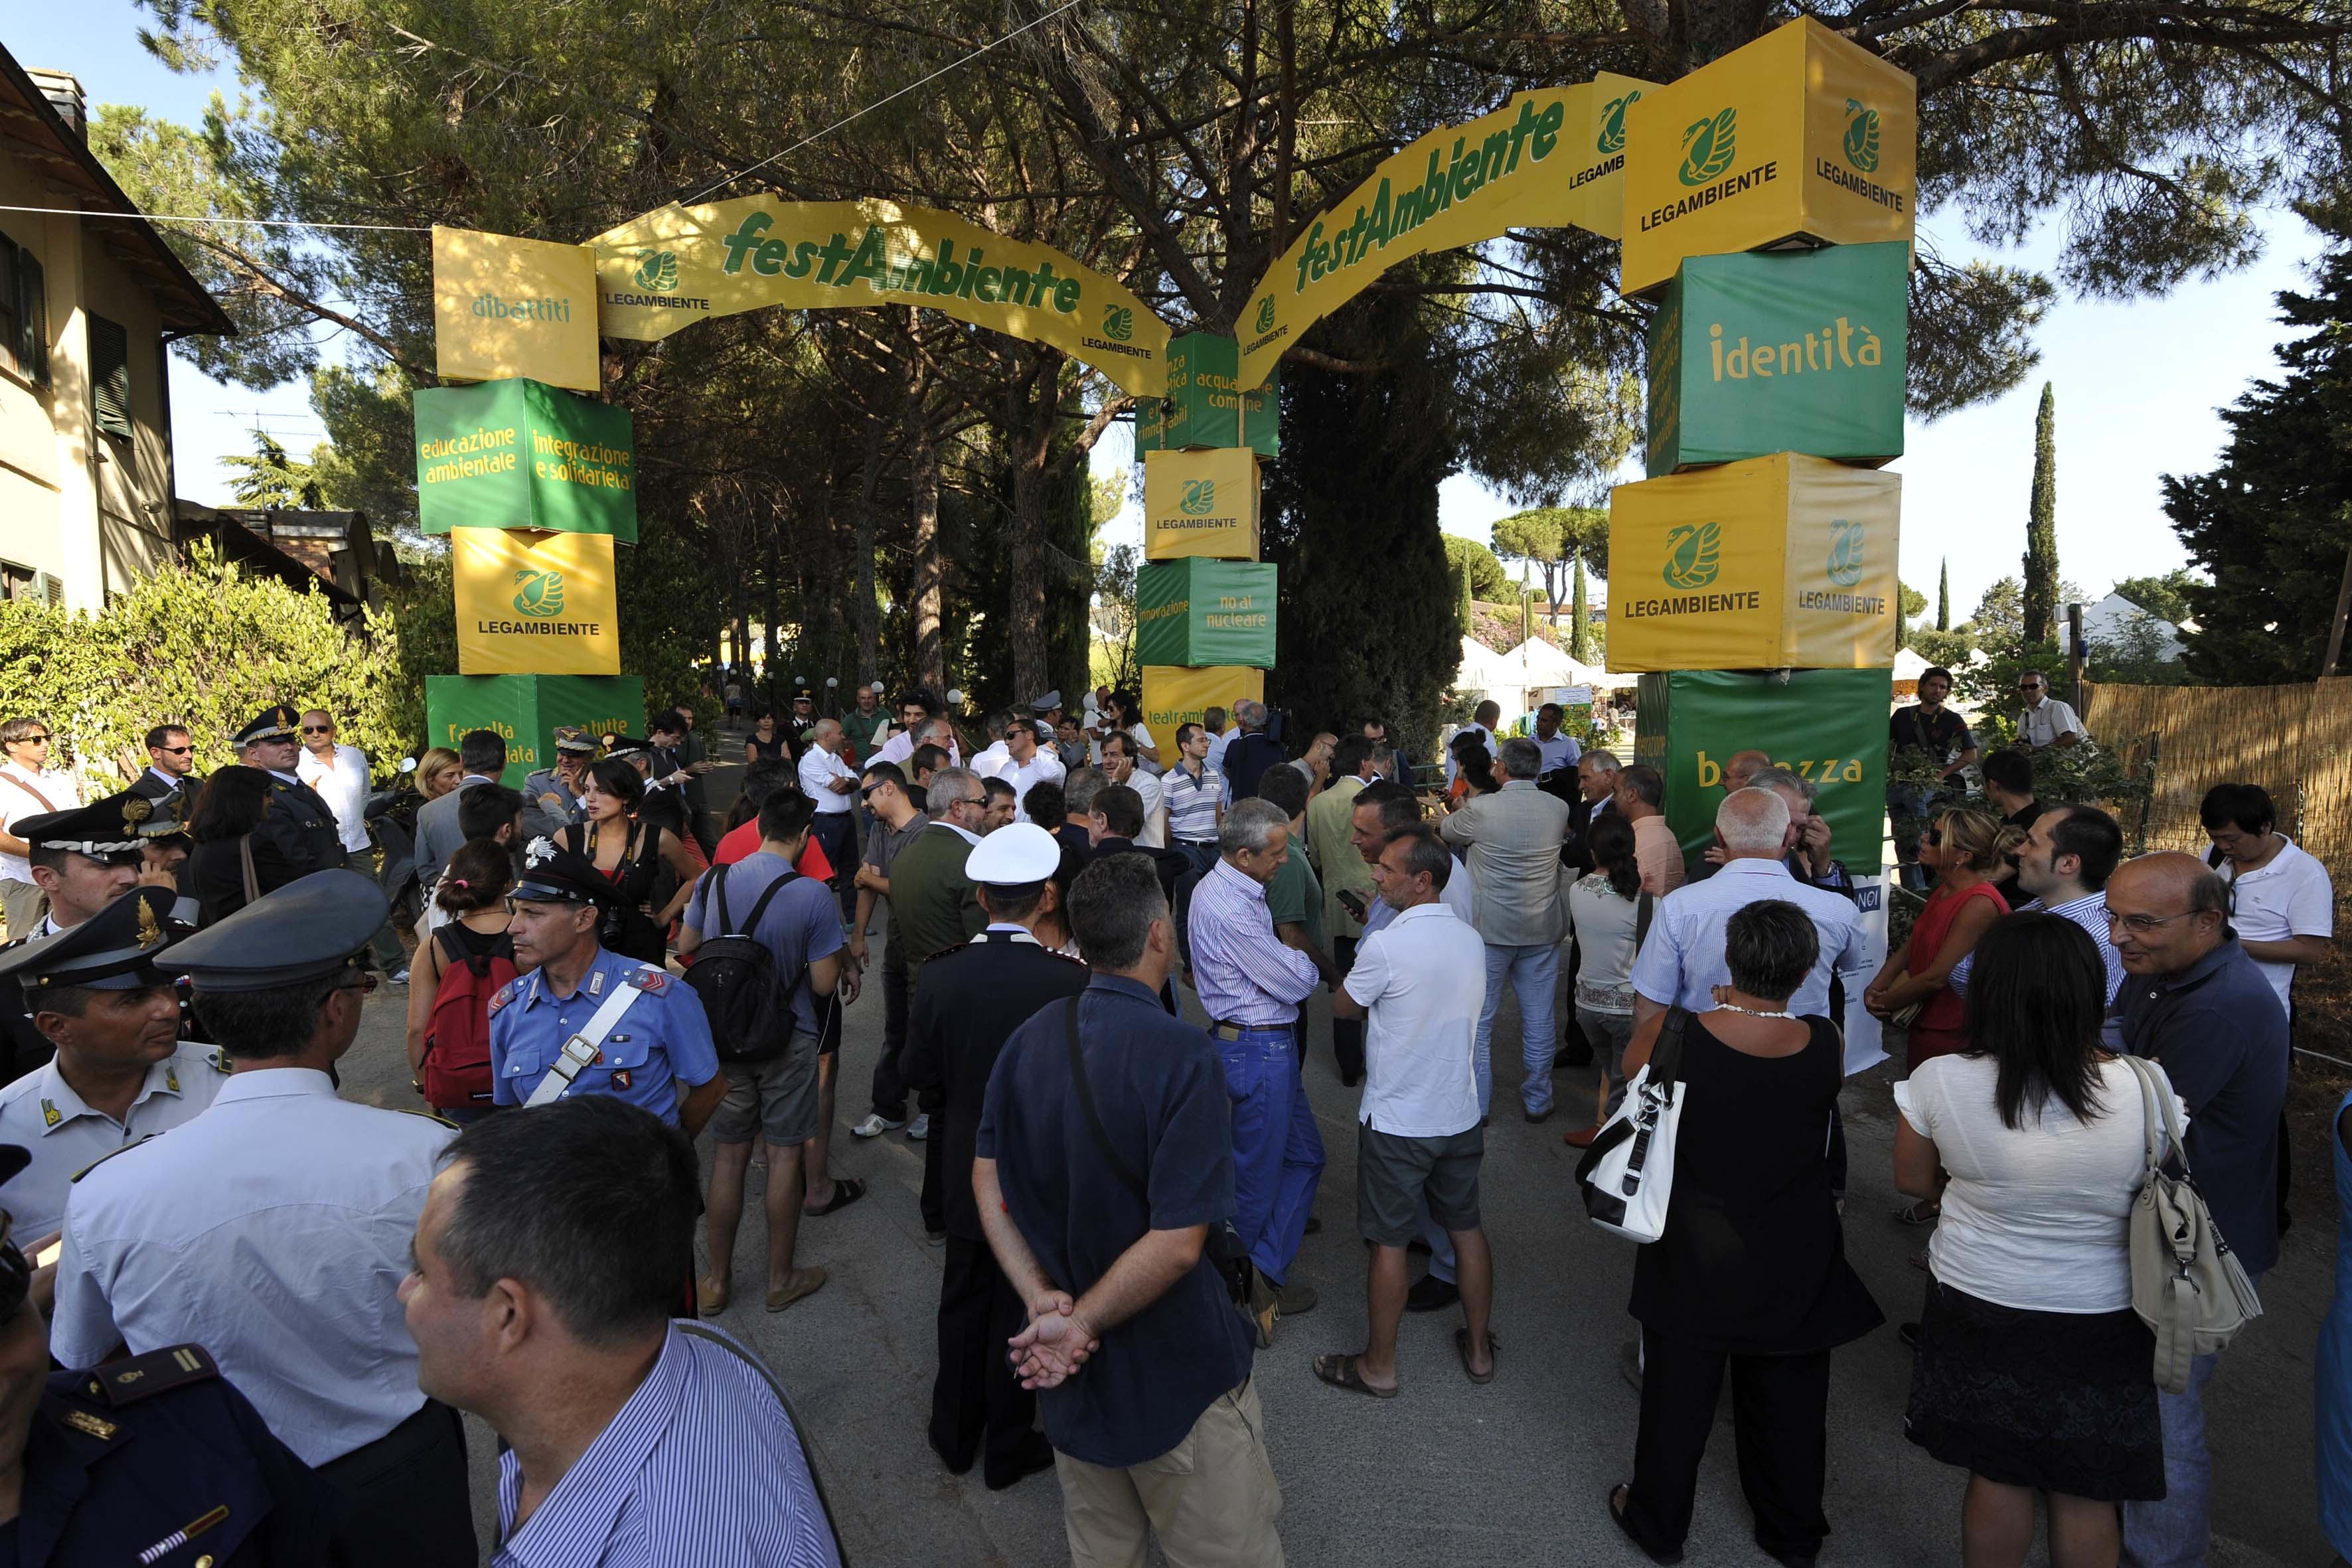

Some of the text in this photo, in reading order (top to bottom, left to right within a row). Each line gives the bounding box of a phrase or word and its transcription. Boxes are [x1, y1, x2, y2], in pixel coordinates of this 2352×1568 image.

[1569, 154, 1624, 191] LEGAMB
[1816, 157, 1903, 213] LEGAMBIENTE
[1295, 99, 1564, 295] festAmbiente
[1641, 161, 1777, 232] LEGAMBIENTE
[722, 212, 1081, 314] festAmbiente
[472, 294, 570, 323] dibattiti
[605, 293, 710, 310] LEGAMBIENTE
[1082, 337, 1152, 359] LEGAMBIENTE
[1243, 325, 1288, 356] LEGAMBIENTE
[1709, 317, 1881, 382] identità
[1208, 394, 1262, 413] comne
[1138, 404, 1187, 443] rinnoabili
[422, 428, 516, 459] educazione
[532, 429, 629, 467] integrazione
[426, 452, 516, 483] ambientale
[536, 460, 546, 479] e
[1157, 518, 1237, 529] LEGAMBIENTE
[1139, 599, 1189, 623] innovazione
[1220, 595, 1253, 609] no al
[1625, 591, 1760, 618] LEGAMBIENTE
[1799, 590, 1885, 615] LEGAMBIENTE
[478, 621, 599, 636] LEGAMBIENTE
[1206, 613, 1267, 627] nucleare
[591, 718, 627, 736] tutte
[1149, 708, 1236, 724] teatrambte
[448, 721, 514, 742] ralta
[1697, 751, 1862, 787] bzza
[1859, 890, 1878, 907] NOI
